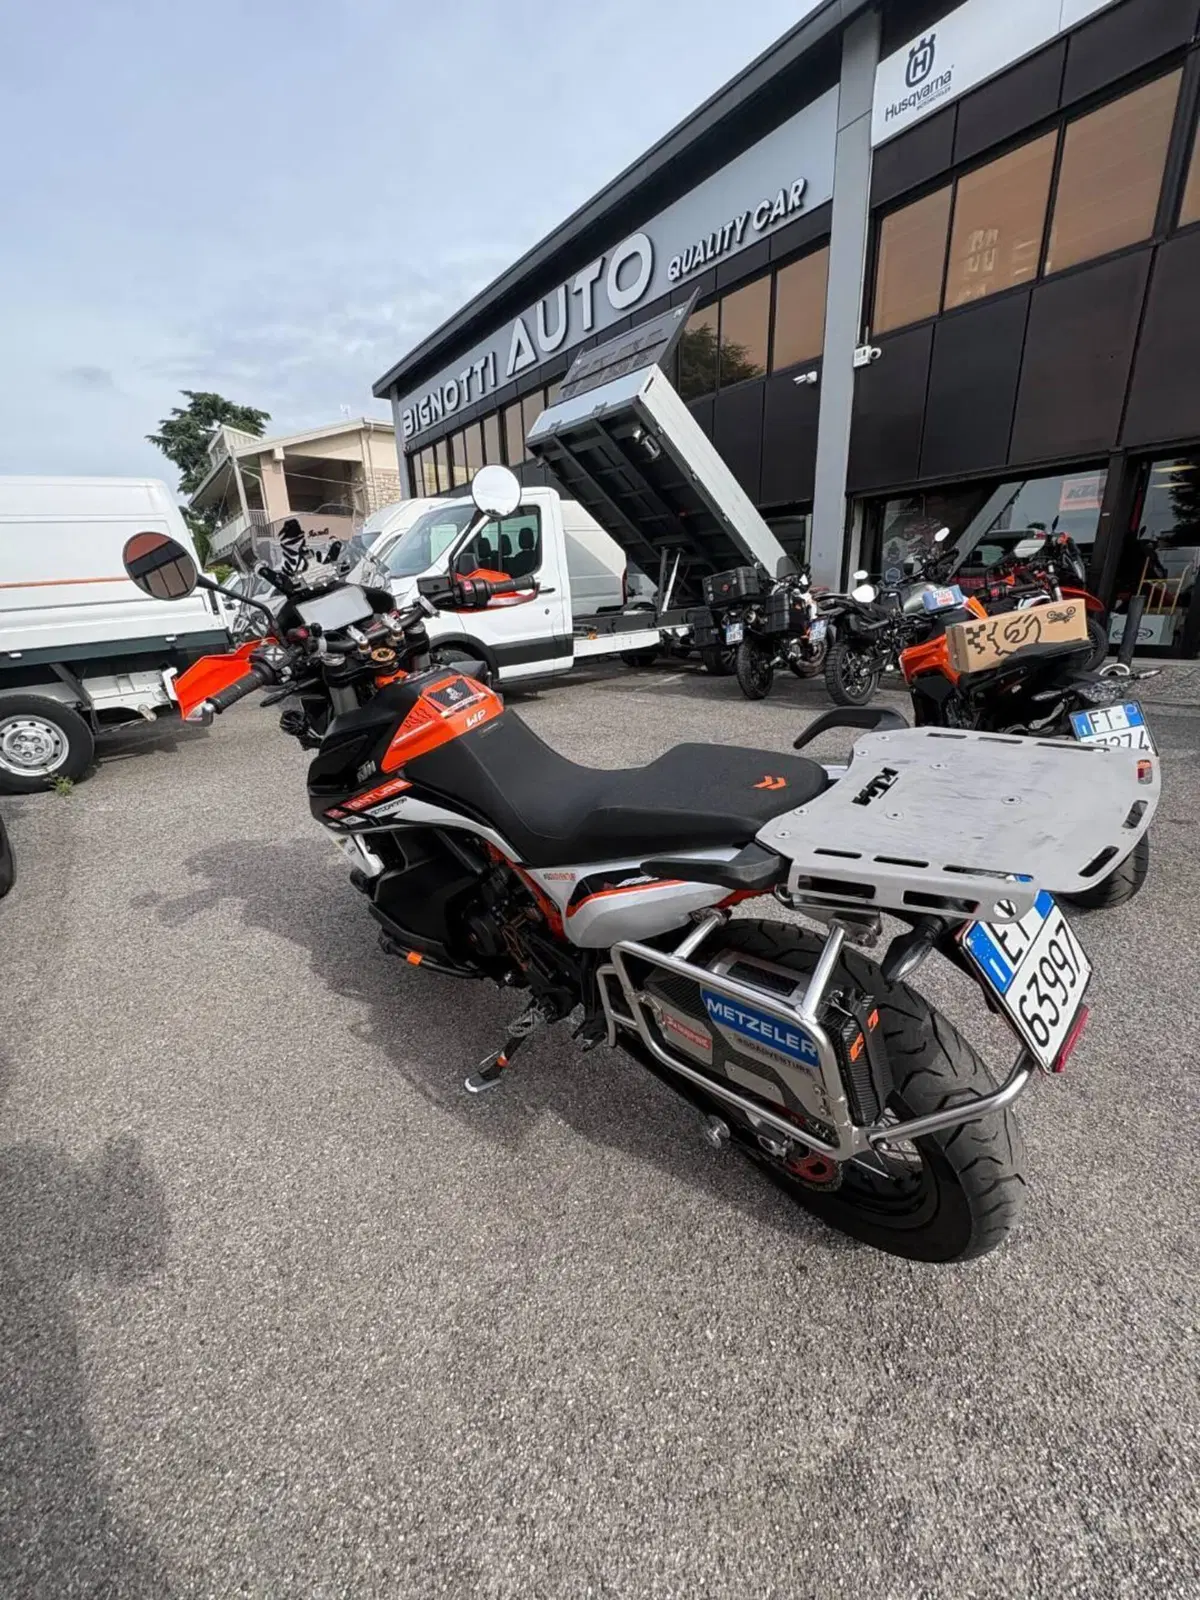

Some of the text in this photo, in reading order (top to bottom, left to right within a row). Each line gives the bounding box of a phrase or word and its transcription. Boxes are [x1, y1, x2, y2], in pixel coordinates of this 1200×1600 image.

[884, 70, 953, 122] Husqvarna
[402, 177, 807, 438] BIGNOTTI AUTO QUALITY CAR
[465, 709, 487, 728] WP
[1088, 709, 1114, 733] FT
[851, 767, 899, 807] KTM
[1019, 919, 1081, 1048] 63997
[706, 997, 818, 1058] METZELER
